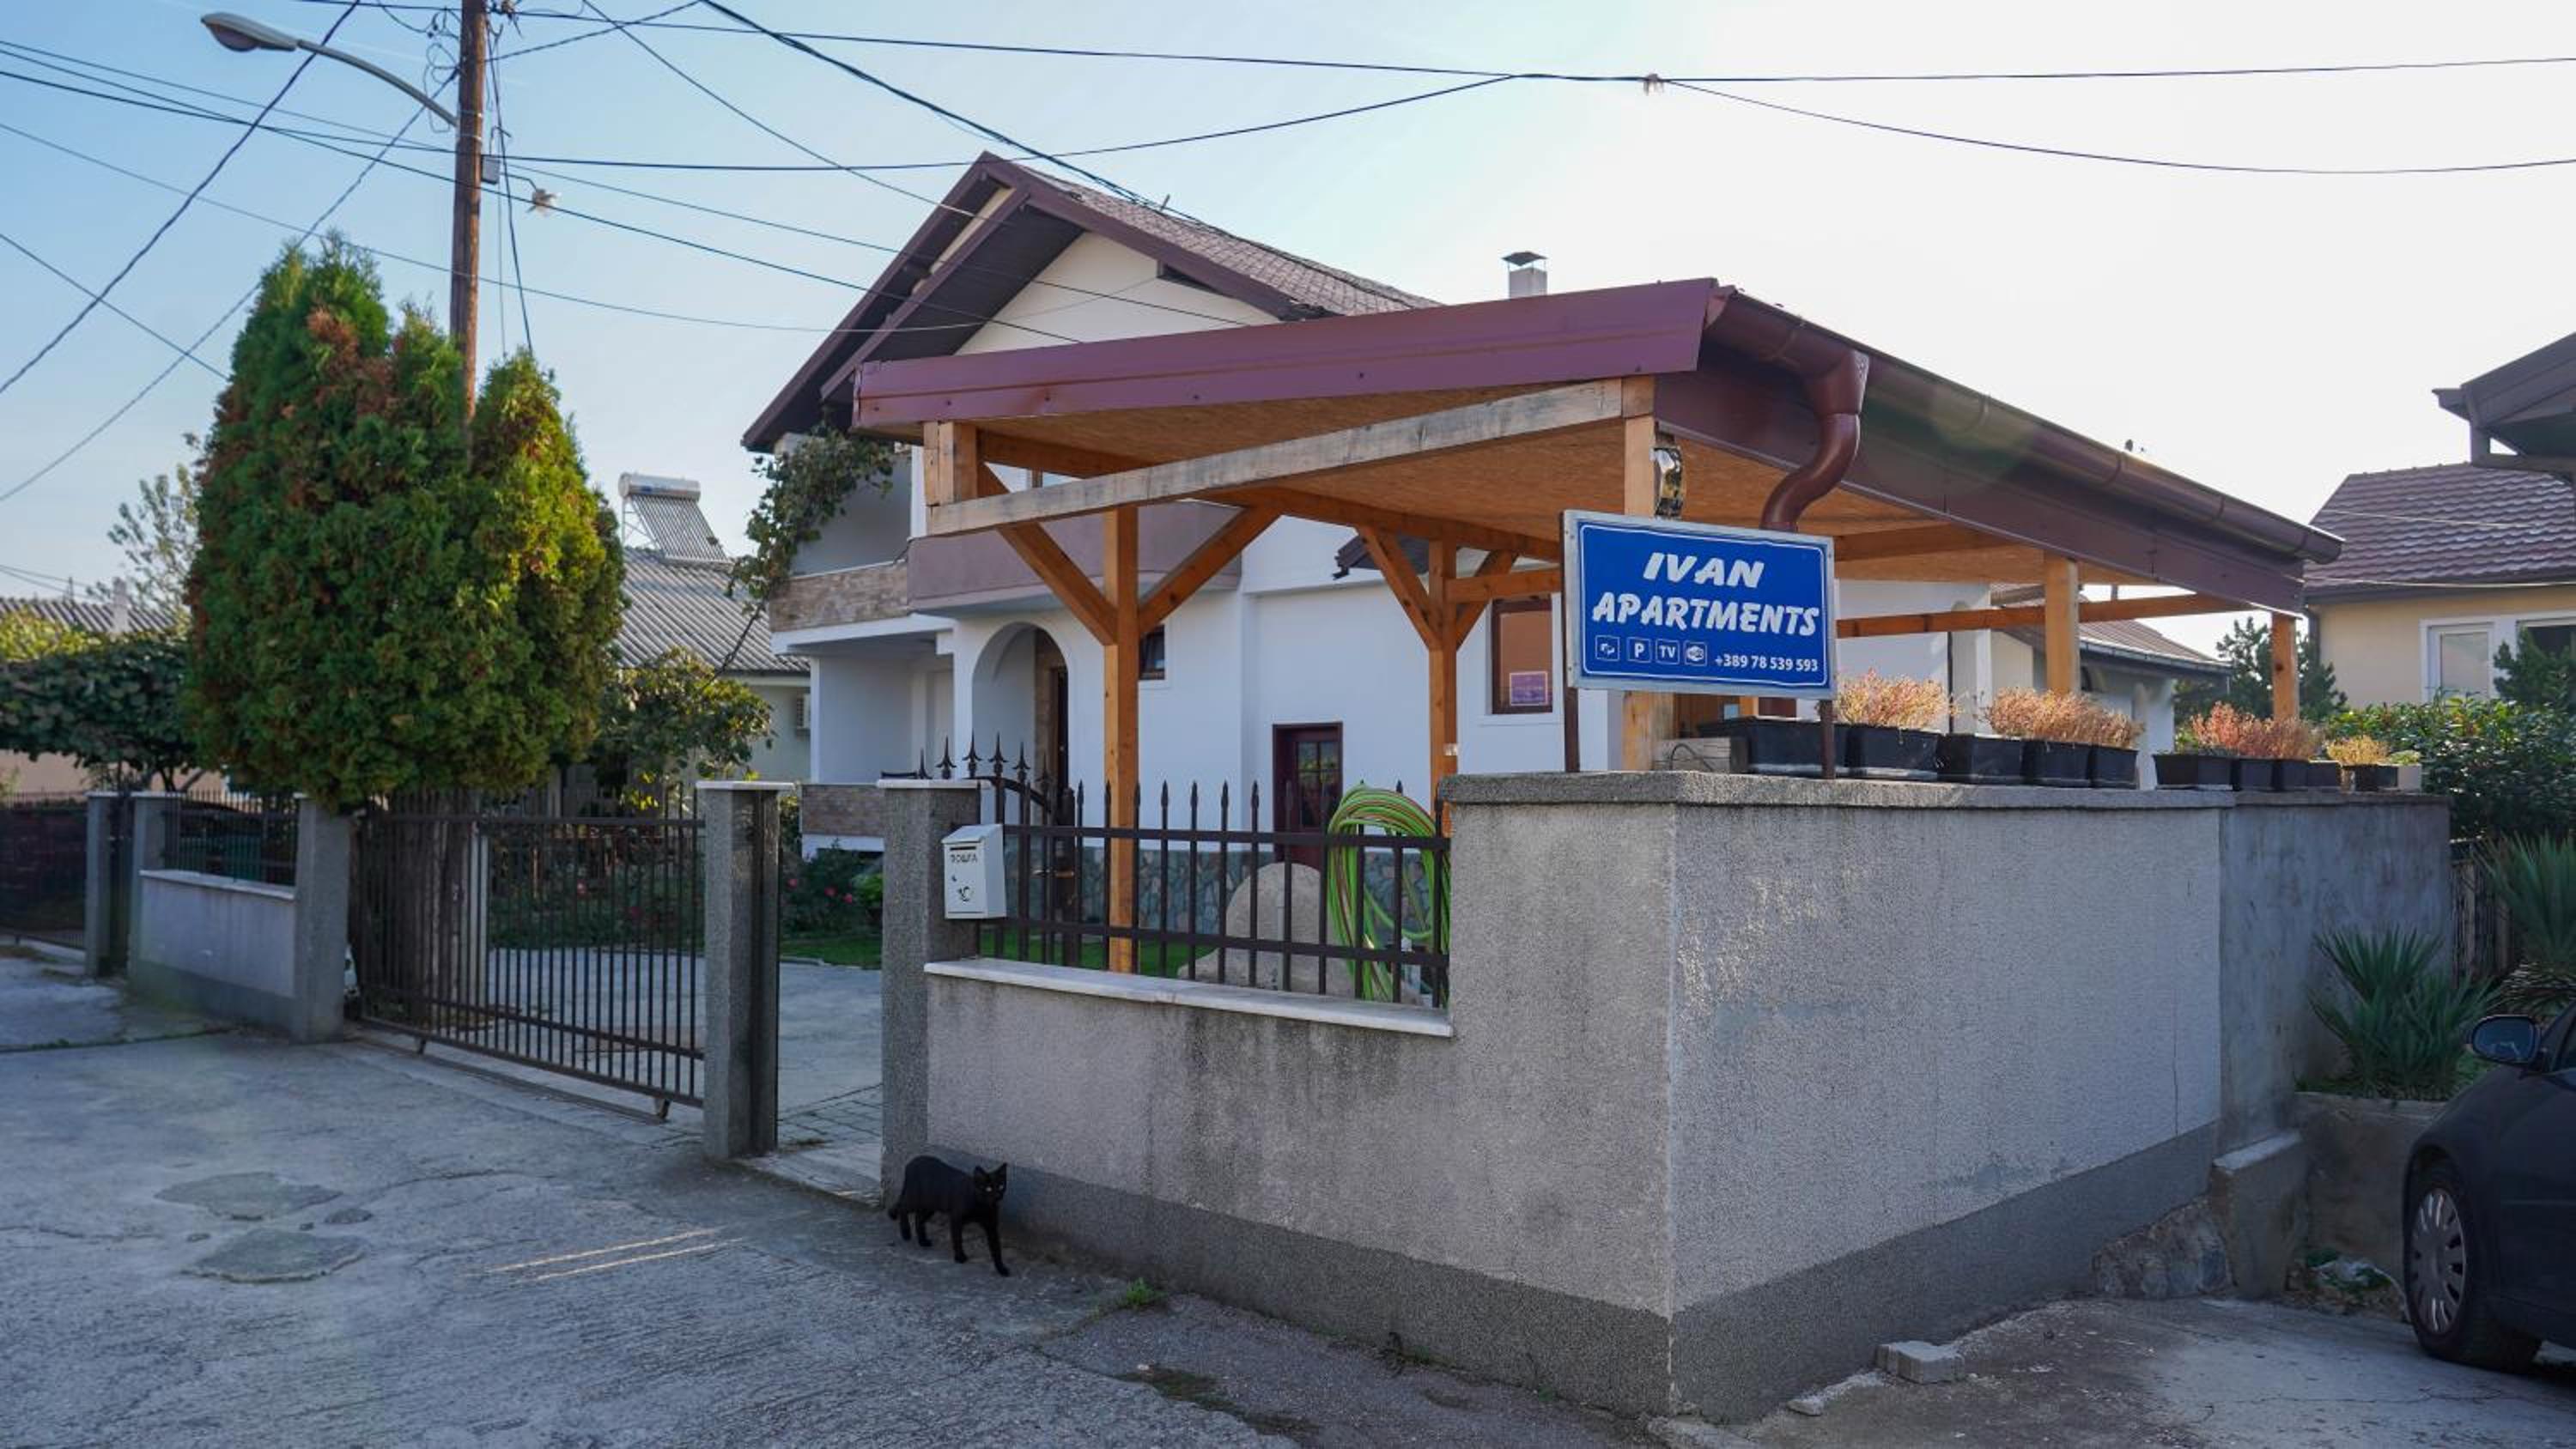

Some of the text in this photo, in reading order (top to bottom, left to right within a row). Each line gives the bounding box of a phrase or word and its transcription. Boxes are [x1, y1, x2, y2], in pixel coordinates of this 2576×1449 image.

[1643, 552, 1765, 588] IVAN
[1592, 592, 1820, 636] APARTMENTS
[1634, 642, 1644, 658] P
[1659, 645, 1676, 658] TV
[1715, 653, 1748, 669] +389
[1751, 655, 1767, 669] 78
[1770, 657, 1794, 670] 539
[1795, 658, 1819, 672] 593
